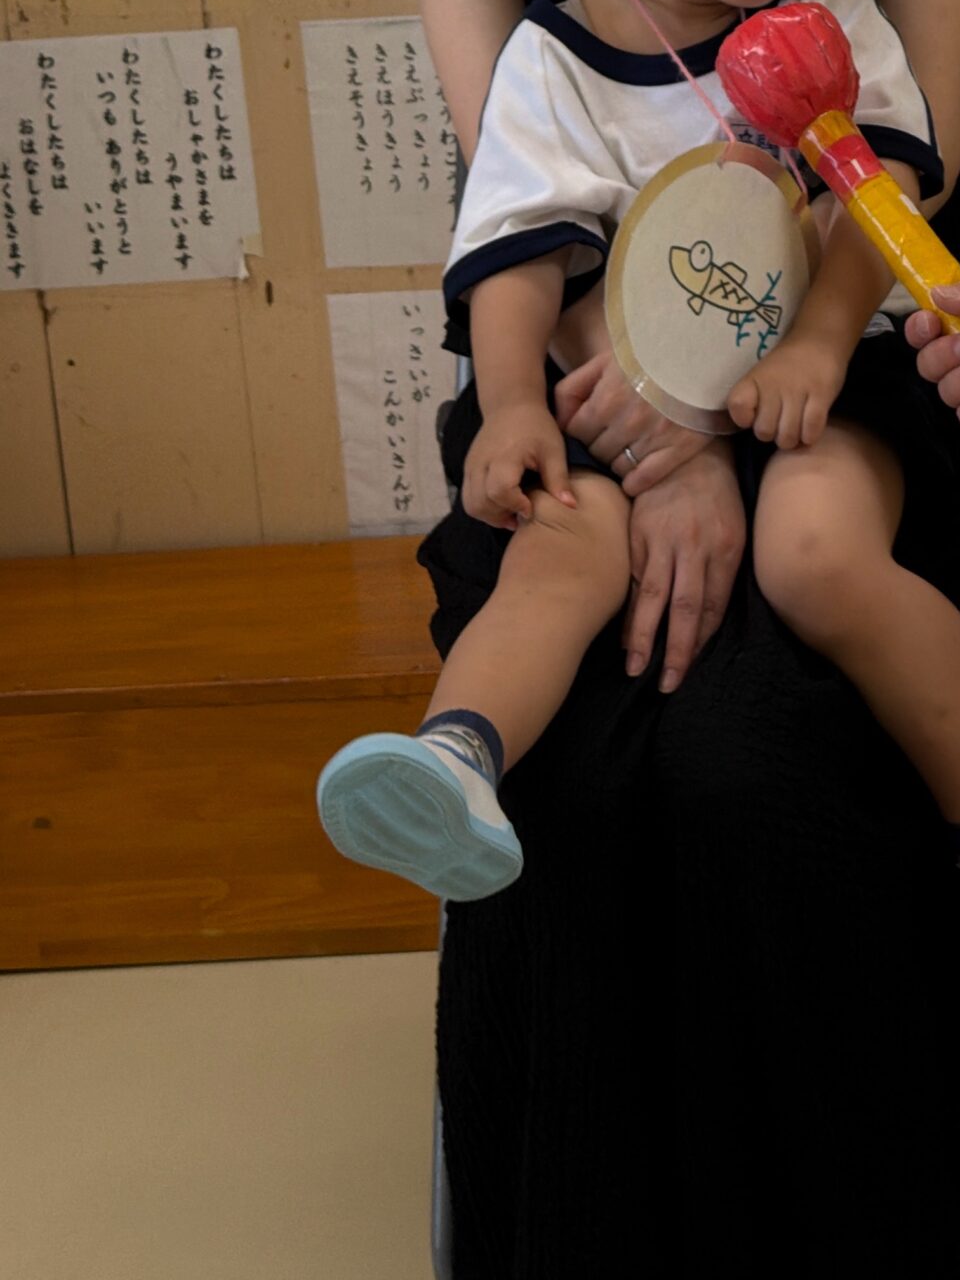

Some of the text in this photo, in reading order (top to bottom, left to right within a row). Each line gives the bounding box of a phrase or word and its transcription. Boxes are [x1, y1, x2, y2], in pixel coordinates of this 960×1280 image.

[19, 119, 44, 216] おはなしを
[38, 52, 69, 190] わたくしたちは
[122, 48, 153, 185] わたくしたちは
[184, 89, 214, 226] おしゃかさまを
[205, 43, 237, 181] わたくしたちは
[84, 202, 109, 275] いいます
[165, 154, 193, 270] うやまいます
[384, 370, 413, 511] こんかいさんげ
